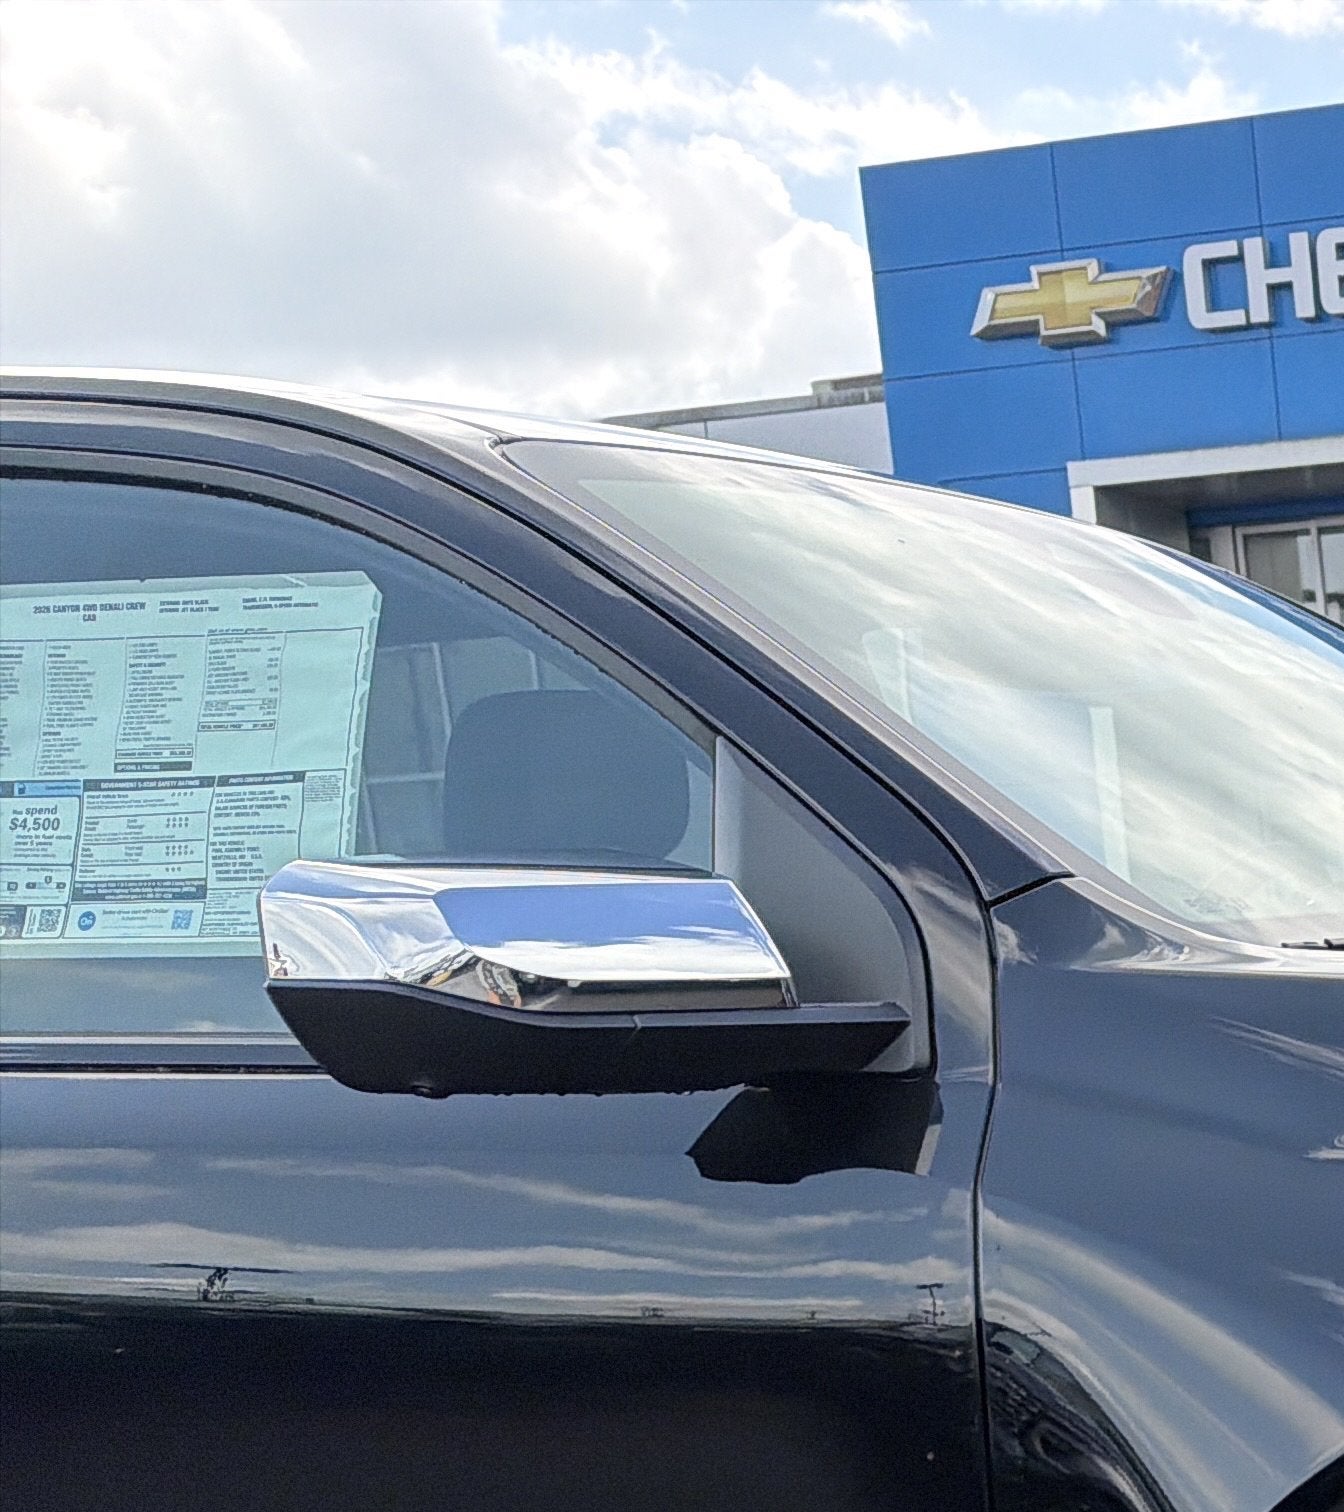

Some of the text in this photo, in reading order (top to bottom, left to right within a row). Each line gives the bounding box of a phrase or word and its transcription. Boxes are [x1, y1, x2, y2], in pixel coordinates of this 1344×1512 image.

[53, 604, 81, 613] CANYON
[100, 602, 125, 611] DENALI
[126, 601, 147, 611] CREW
[83, 613, 97, 622] CAB
[25, 804, 58, 817] spend
[9, 817, 60, 832] $4,500
